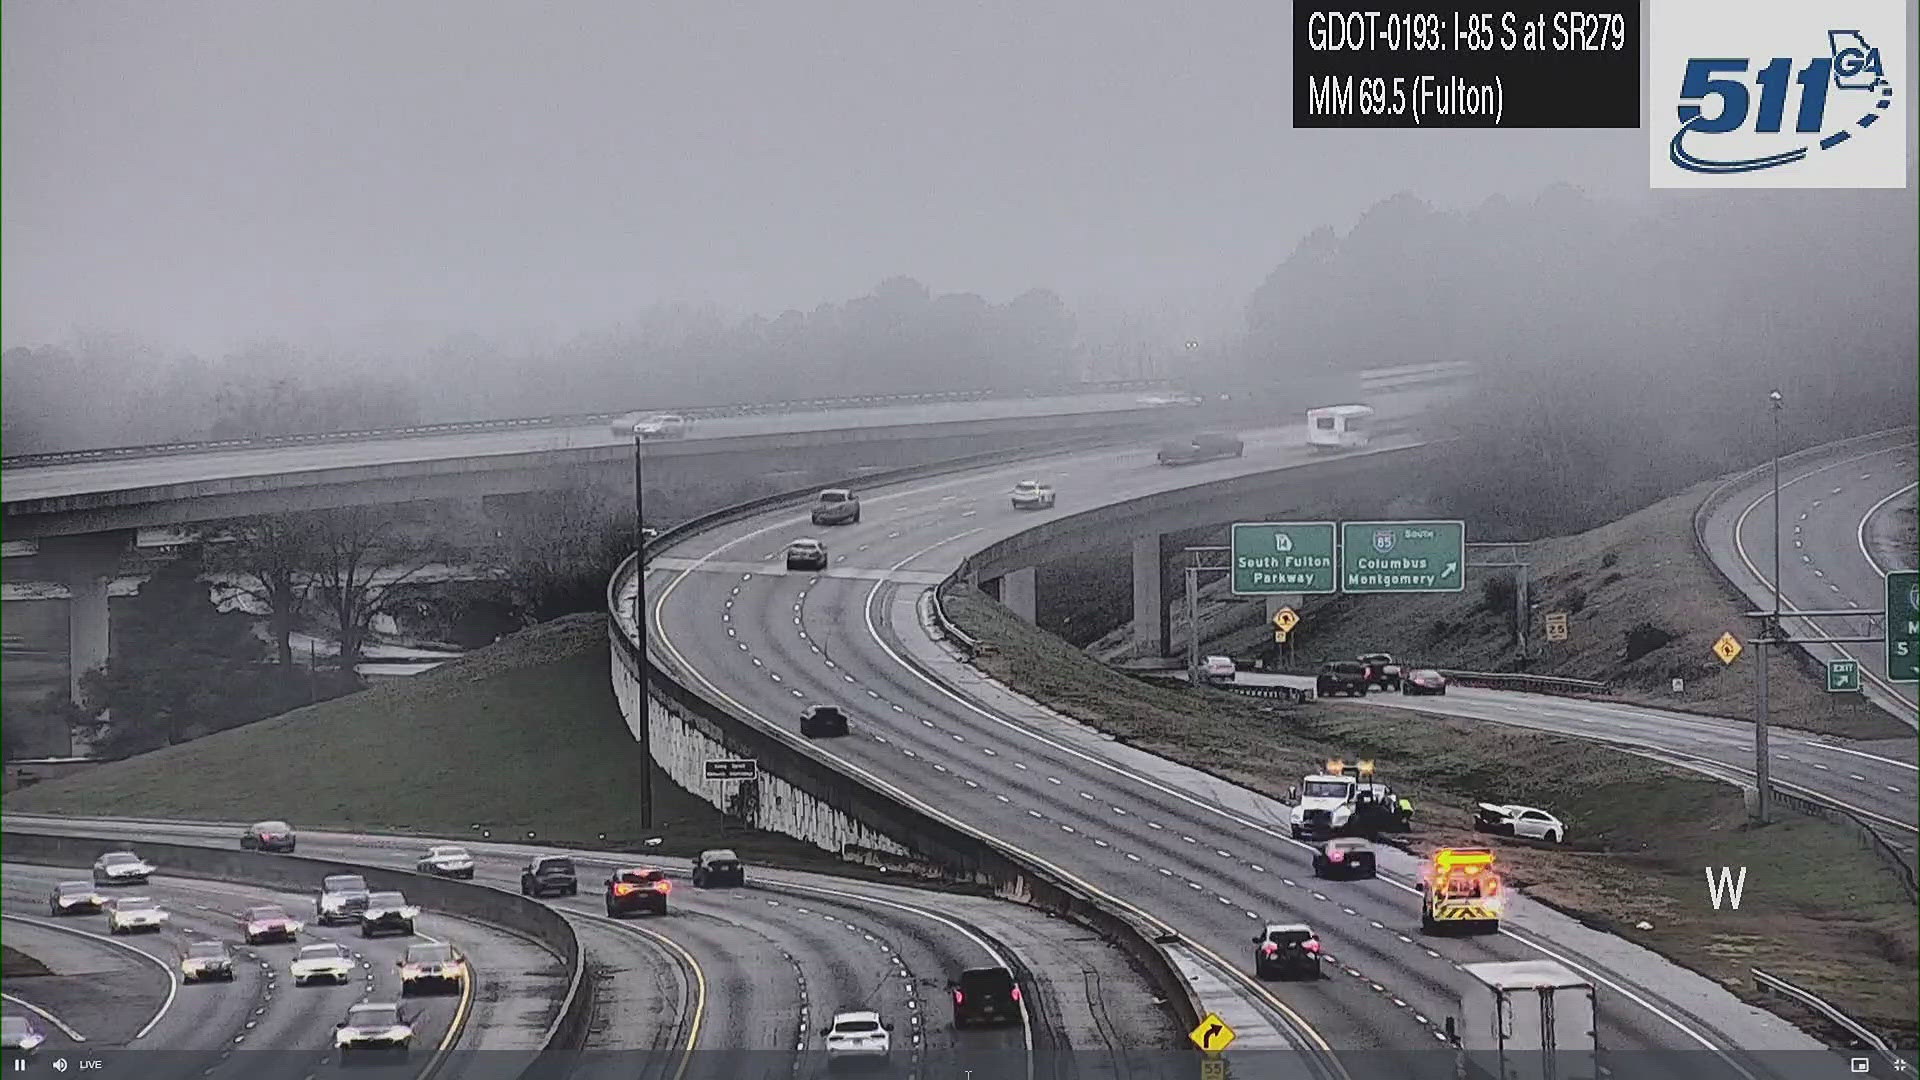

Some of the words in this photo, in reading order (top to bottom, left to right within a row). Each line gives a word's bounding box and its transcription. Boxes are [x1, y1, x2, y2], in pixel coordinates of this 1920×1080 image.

[1377, 536, 1391, 548] 85
[1238, 556, 1278, 569] South
[1285, 556, 1330, 568] Fulton
[1358, 558, 1427, 569] Columbus
[1253, 572, 1315, 586] Parkway
[1349, 573, 1435, 587] Montgomery
[1833, 663, 1853, 672] EXIT
[1205, 1064, 1221, 1074] 55
